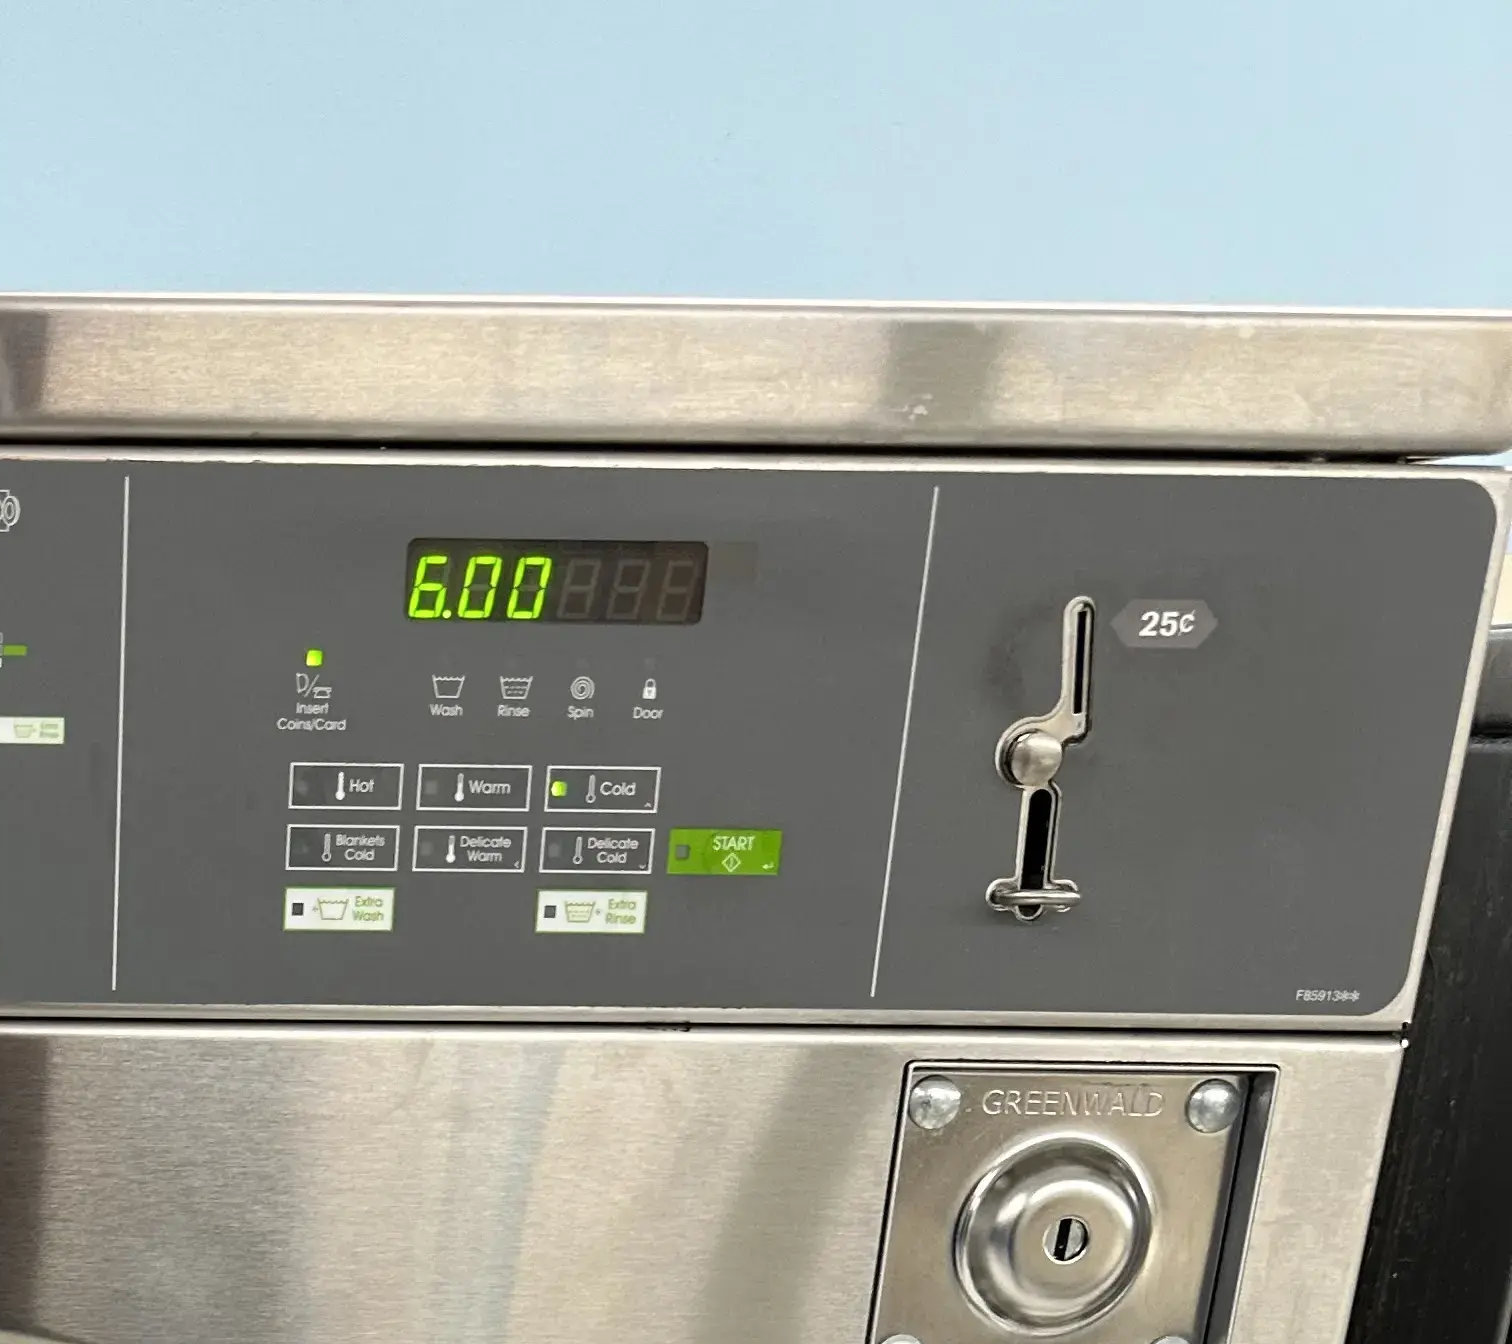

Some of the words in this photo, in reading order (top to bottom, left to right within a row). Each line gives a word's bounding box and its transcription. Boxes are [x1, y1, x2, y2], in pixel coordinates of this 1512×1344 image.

[408, 555, 552, 619] 6.00
[1139, 610, 1195, 637] 25¢
[296, 703, 329, 714] Insert
[430, 704, 463, 716] Wash
[498, 705, 530, 716] Rinse
[568, 706, 593, 720] Spin
[633, 707, 663, 719] Door
[277, 718, 346, 731] Coins/Card
[349, 779, 374, 792] Hot
[469, 780, 510, 794] Warm
[600, 782, 636, 795] Cold
[336, 834, 385, 848] Blankets
[460, 836, 511, 852] Delicate
[588, 837, 638, 853] Delicate
[713, 836, 754, 851] START
[345, 845, 374, 860] Cold
[467, 851, 502, 861] Warm
[597, 852, 627, 863] Cold
[355, 897, 383, 907] Extra
[608, 900, 636, 911] Extra
[353, 911, 383, 922] Wash
[605, 913, 636, 924] Rinse
[982, 1089, 1164, 1117] GREENWALD
